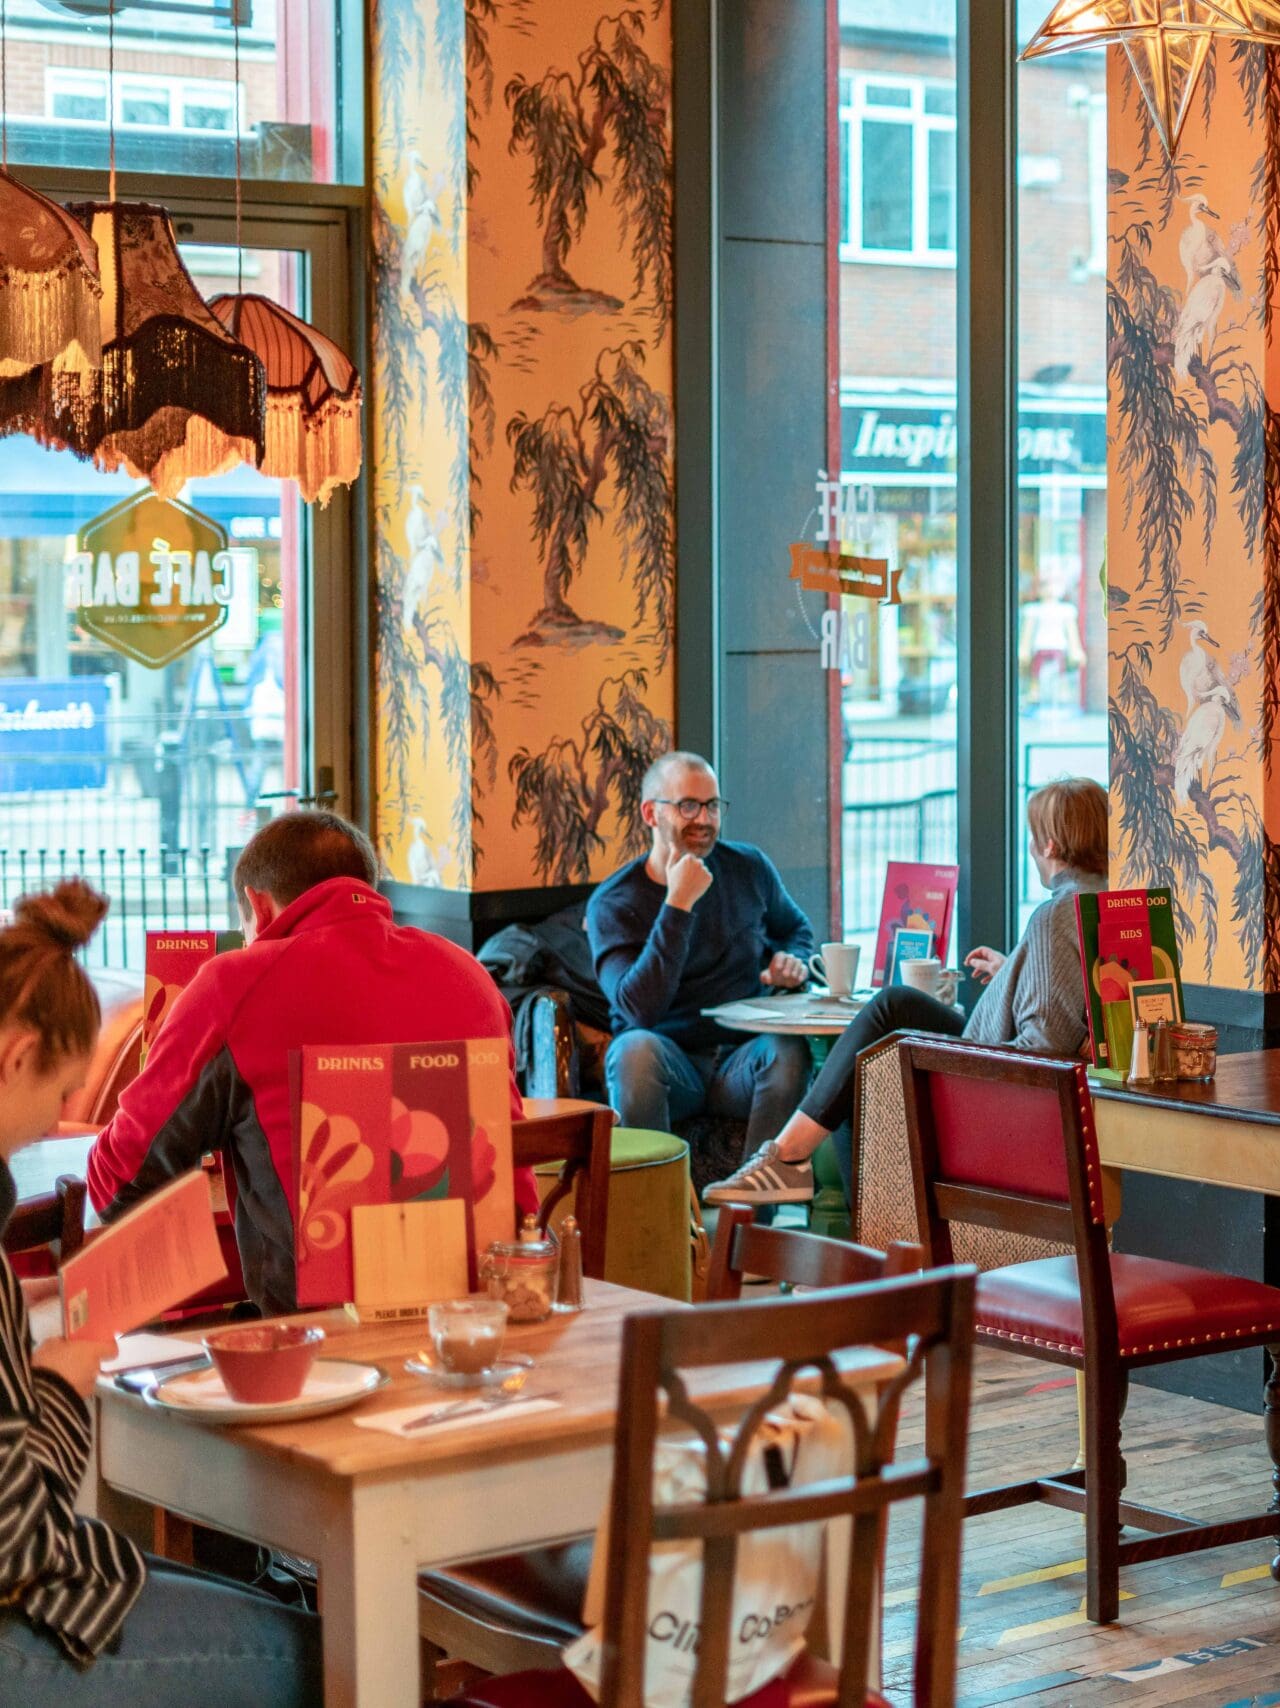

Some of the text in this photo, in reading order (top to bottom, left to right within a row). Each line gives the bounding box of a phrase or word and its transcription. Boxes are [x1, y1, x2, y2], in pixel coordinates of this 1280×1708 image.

[1107, 897, 1143, 909] DRINKS
[1146, 896, 1168, 906] OOD
[1119, 929, 1143, 939] KIDS
[155, 938, 210, 950] DRINKS
[316, 1056, 385, 1071] DRINKS
[409, 1054, 459, 1070] FOOD
